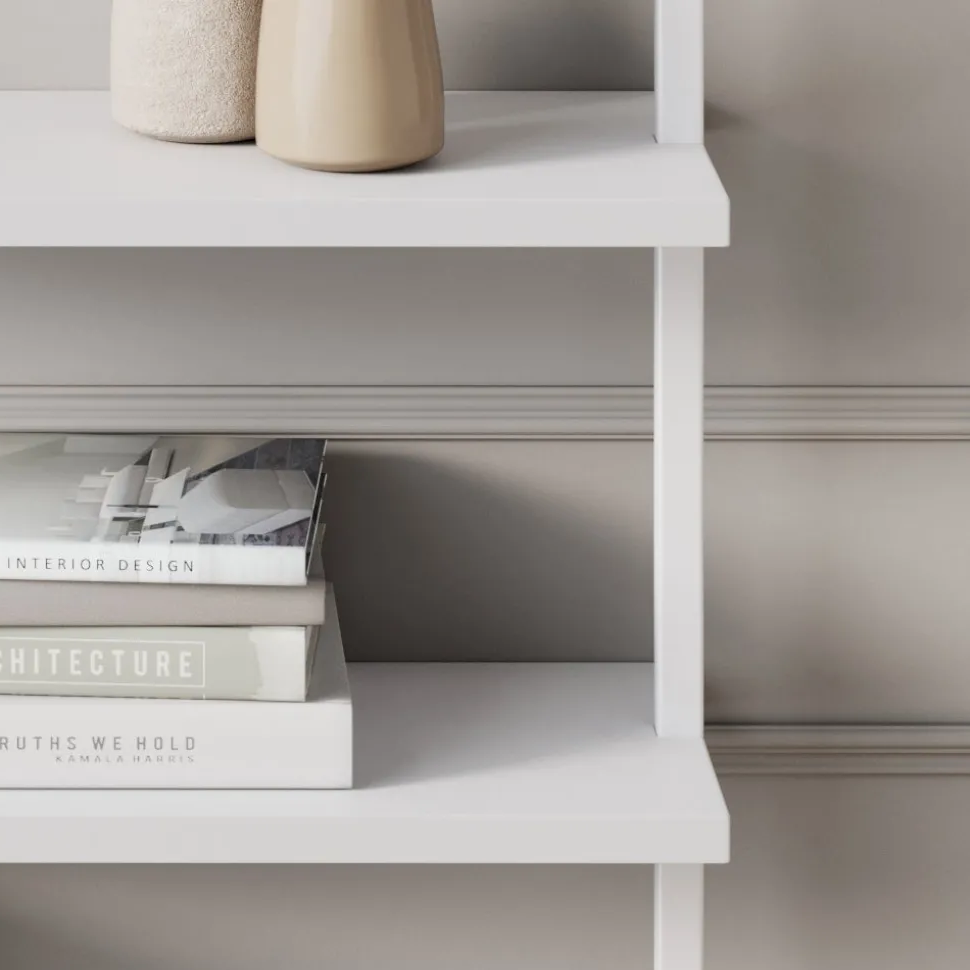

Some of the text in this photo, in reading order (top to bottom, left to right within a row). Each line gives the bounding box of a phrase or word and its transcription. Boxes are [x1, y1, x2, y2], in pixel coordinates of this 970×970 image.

[7, 557, 105, 571] INTERIOR
[119, 559, 194, 573] DESIGN
[92, 736, 123, 751] WE
[136, 736, 196, 751] HOLD
[55, 755, 196, 764] KAMALA HARRIS
